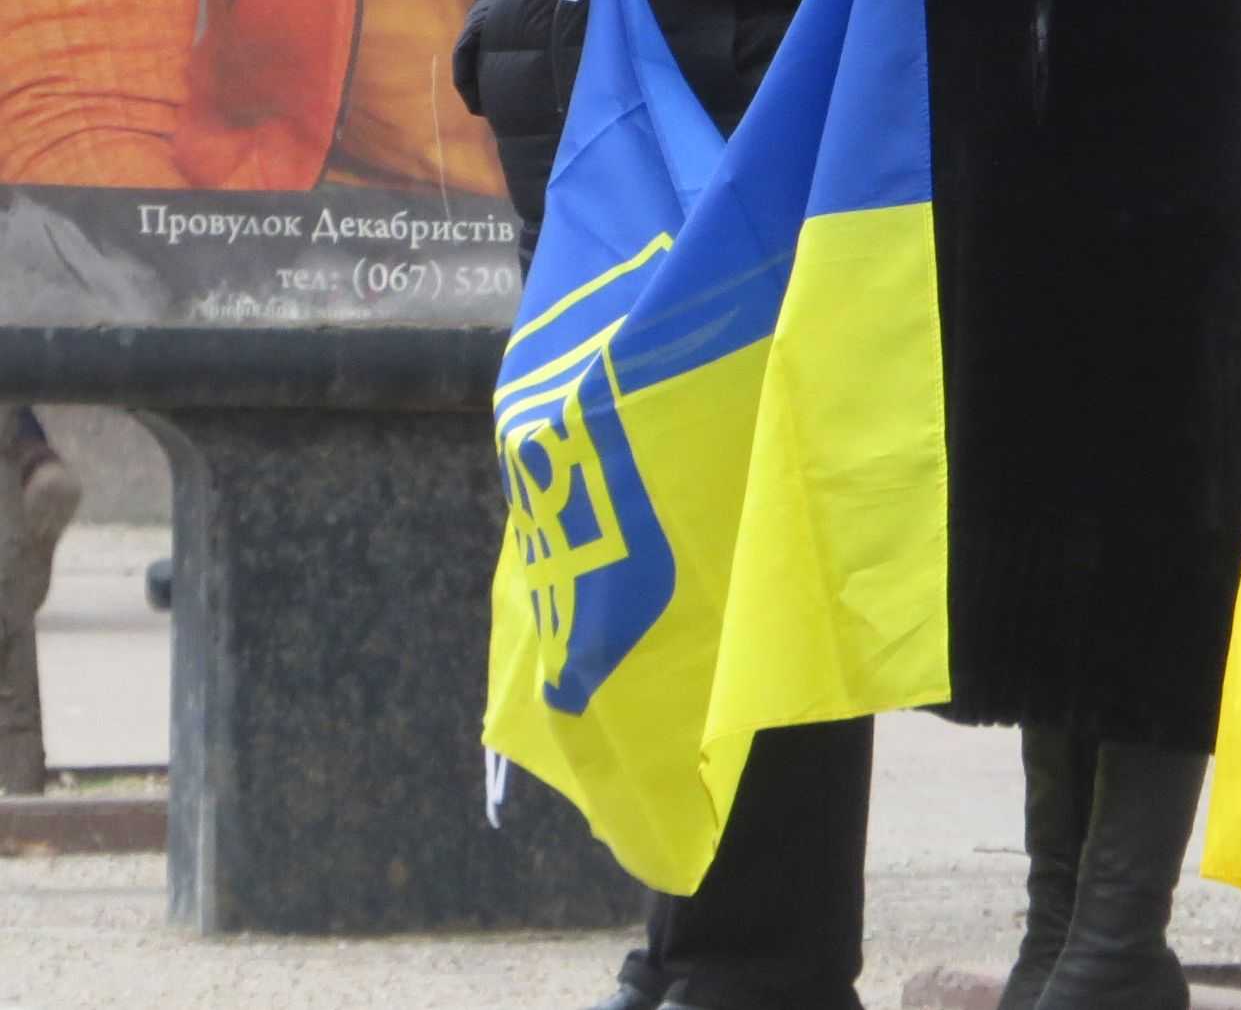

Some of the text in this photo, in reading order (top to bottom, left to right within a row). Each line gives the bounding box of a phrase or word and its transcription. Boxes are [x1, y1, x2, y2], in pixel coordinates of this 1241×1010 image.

[139, 205, 515, 249] Провулок Декабристів
[352, 258, 442, 299] (067)
